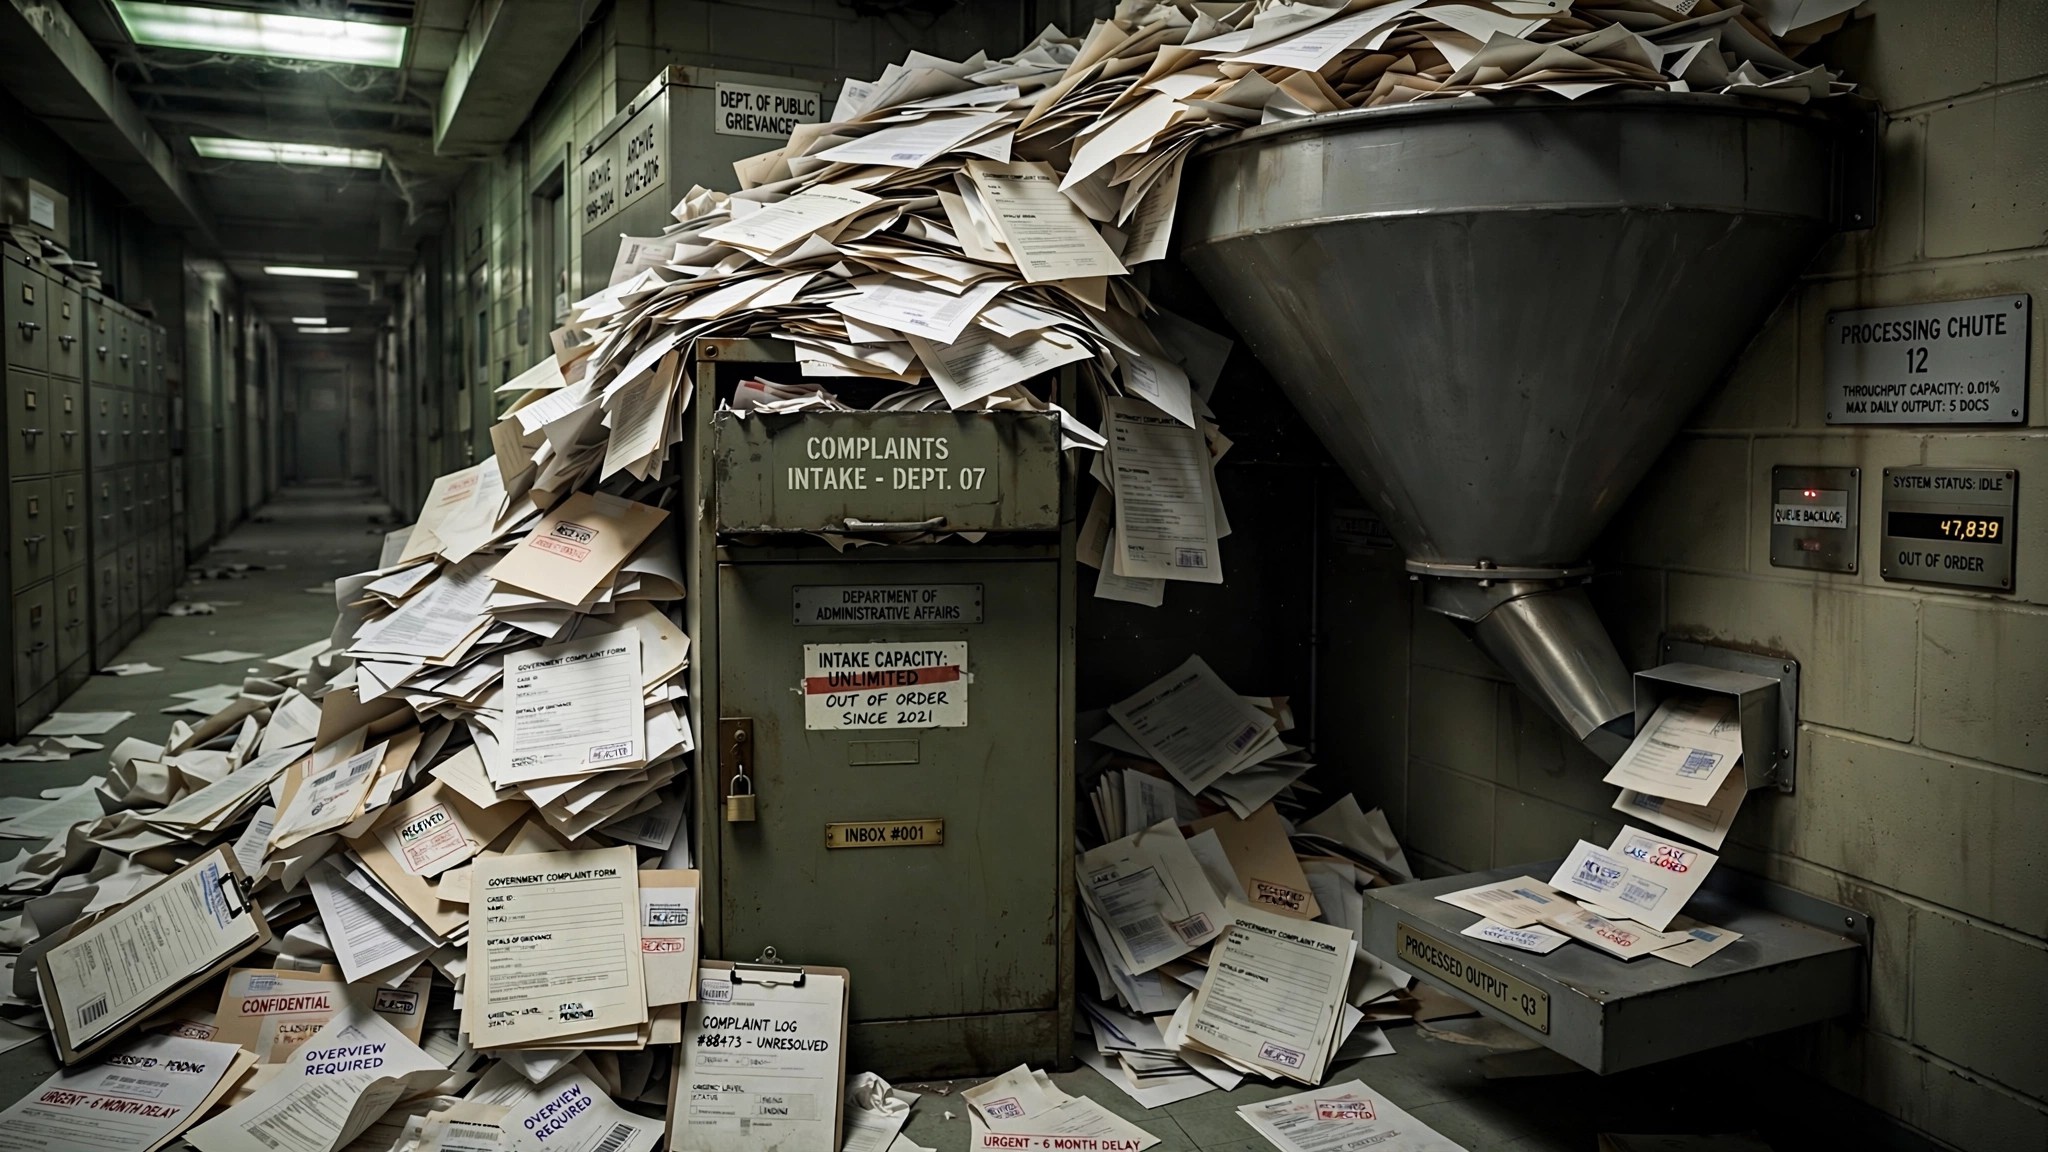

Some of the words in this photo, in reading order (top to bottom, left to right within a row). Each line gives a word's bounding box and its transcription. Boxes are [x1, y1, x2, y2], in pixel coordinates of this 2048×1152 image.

[720, 90, 753, 111] DEPT.
[756, 94, 771, 112] OF
[775, 96, 816, 117] PUBLIC
[1841, 318, 1941, 345] PROCESSING
[1946, 313, 2008, 338] CHUTE
[1906, 347, 1929, 374] 12
[1910, 382, 1964, 397] CAPACITY:
[1967, 380, 2001, 395] 0.01%
[1846, 401, 1867, 414] MAX
[1870, 400, 1899, 414] DAILY
[1901, 400, 1946, 413] OUTPUT:
[1949, 399, 1957, 413] 5
[1959, 398, 1990, 412] DOCS
[806, 436, 950, 460] COMPLAINTS
[787, 466, 868, 490] INTAKE
[892, 466, 952, 490] DEPT.
[959, 466, 986, 490] 07
[1893, 476, 1931, 490] SYSTEM
[1934, 477, 1976, 490] STATUS:
[1978, 478, 2004, 491] IDLE
[1940, 520, 1999, 541] 47,839
[1898, 551, 1921, 566] OUT
[1925, 553, 1940, 568] OF
[1944, 555, 1985, 573] ORDER
[842, 589, 919, 604] DEPARTMENT
[922, 589, 938, 604] OF
[816, 606, 911, 621] ADMINISTRATIVE
[913, 605, 961, 619] AFFAIRS
[517, 657, 564, 671] GOVERNMENT
[565, 650, 605, 663] COMPLAINT
[606, 646, 627, 656] FORM
[819, 651, 870, 669] INTAKE
[874, 650, 949, 668] CAPACITY:
[828, 669, 919, 688] UNLIMITED
[825, 694, 860, 708] OUT
[866, 692, 889, 706] OF
[895, 691, 949, 706] ORDER
[842, 711, 888, 725] SINCE
[896, 709, 933, 725] 2021
[844, 826, 886, 843] INBOX
[890, 825, 924, 842] #001
[488, 874, 544, 887] GOVERNMENT
[546, 869, 593, 882] COMPLAINT
[593, 868, 617, 878] FORM
[1235, 919, 1277, 936] GOVERNMENT
[1278, 931, 1316, 947] COMPLAINT
[1316, 941, 1336, 953] FORM
[1405, 935, 1463, 978] PROCESSED
[1465, 965, 1509, 1002] OUTPUT
[1521, 993, 1537, 1017] Q3
[241, 996, 331, 1014] CONFIDENTIAL
[702, 1015, 771, 1032] COMPLAINT
[774, 1019, 798, 1033] LOG
[305, 1042, 387, 1062] OVERVIEW
[697, 1033, 742, 1049] #88473
[756, 1036, 829, 1052] UNRESOLVED
[165, 1060, 206, 1074] PENDING
[304, 1057, 384, 1076] REQUIRED
[40, 1091, 88, 1106] URGENT
[90, 1098, 103, 1109] 6
[99, 1098, 143, 1114] MONTH
[140, 1104, 180, 1119] DELAY
[523, 1083, 583, 1131] OVERVIEW
[535, 1095, 593, 1143] REQUIRED
[984, 1136, 1030, 1148] URGENT
[1042, 1137, 1050, 1149] 6
[1054, 1138, 1097, 1150] MONTH
[1102, 1139, 1141, 1151] DELAY
